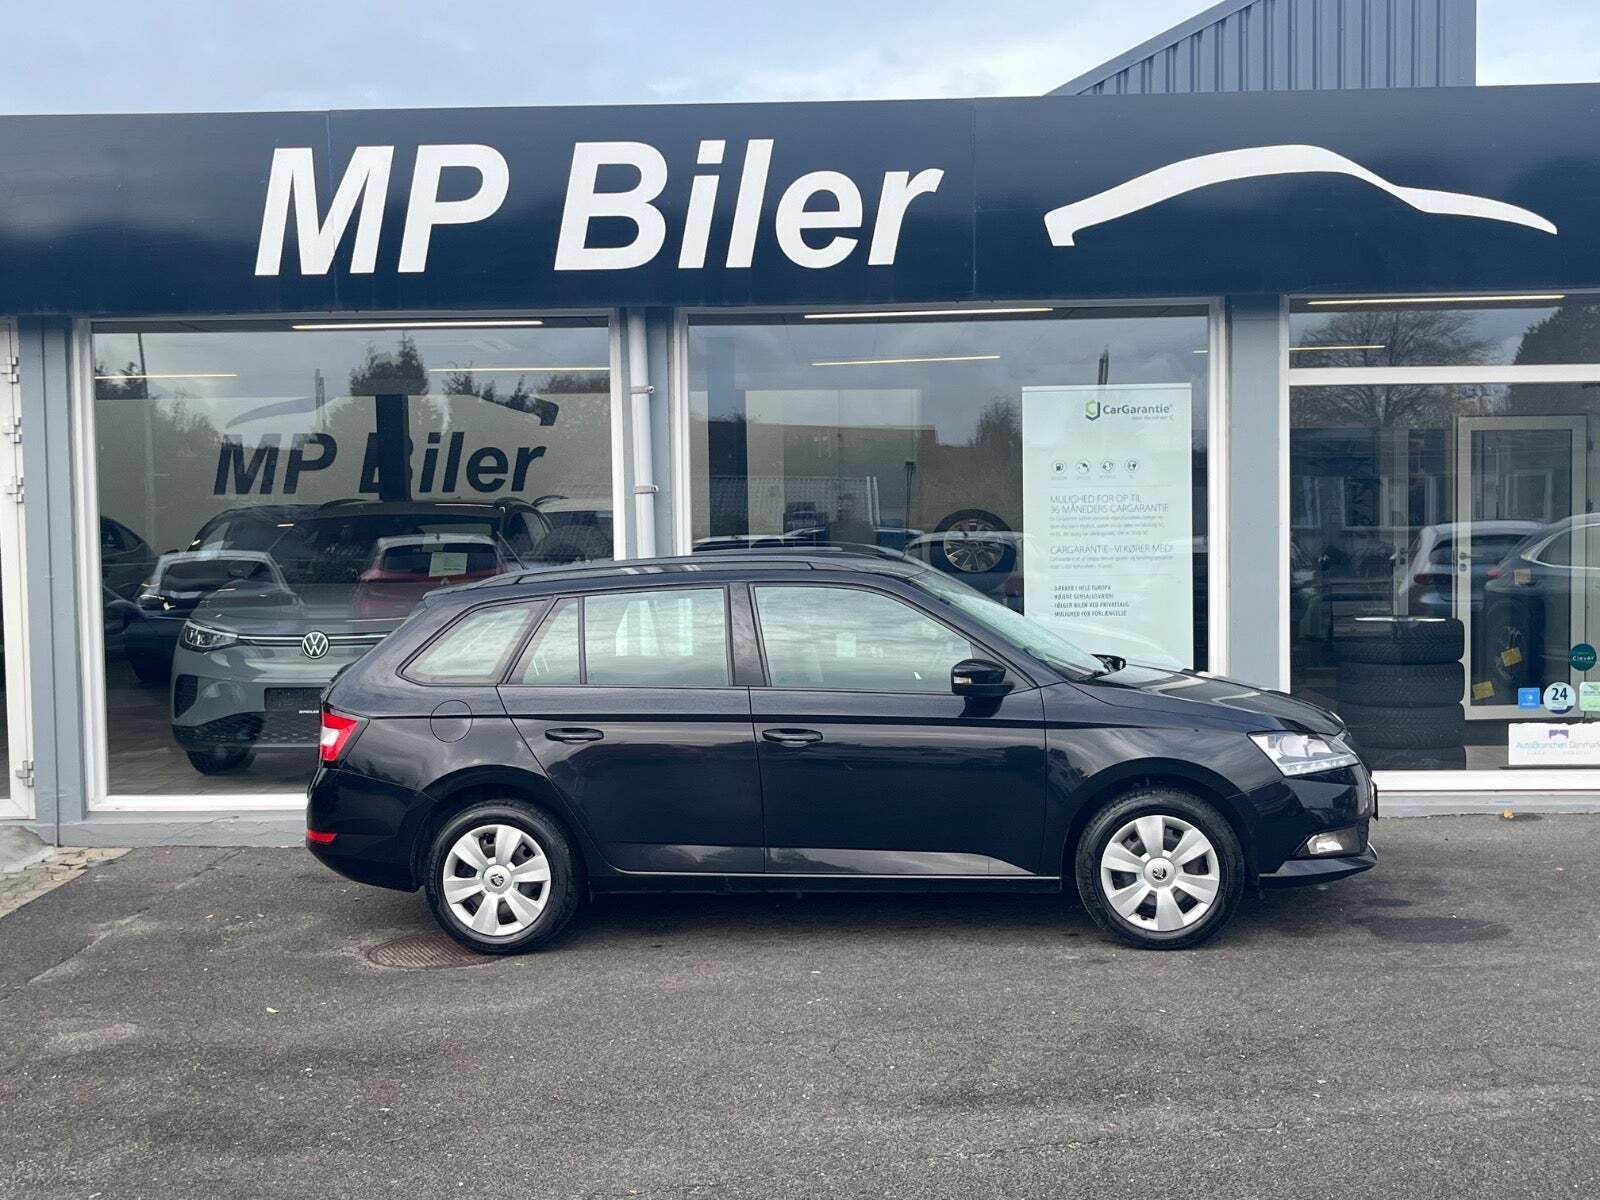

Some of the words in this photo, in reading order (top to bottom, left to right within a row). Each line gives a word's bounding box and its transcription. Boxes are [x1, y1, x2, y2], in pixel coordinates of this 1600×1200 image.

[254, 144, 510, 276] MP
[553, 138, 945, 271] Biler
[213, 432, 338, 496] MP
[1551, 687, 1569, 701] 24
